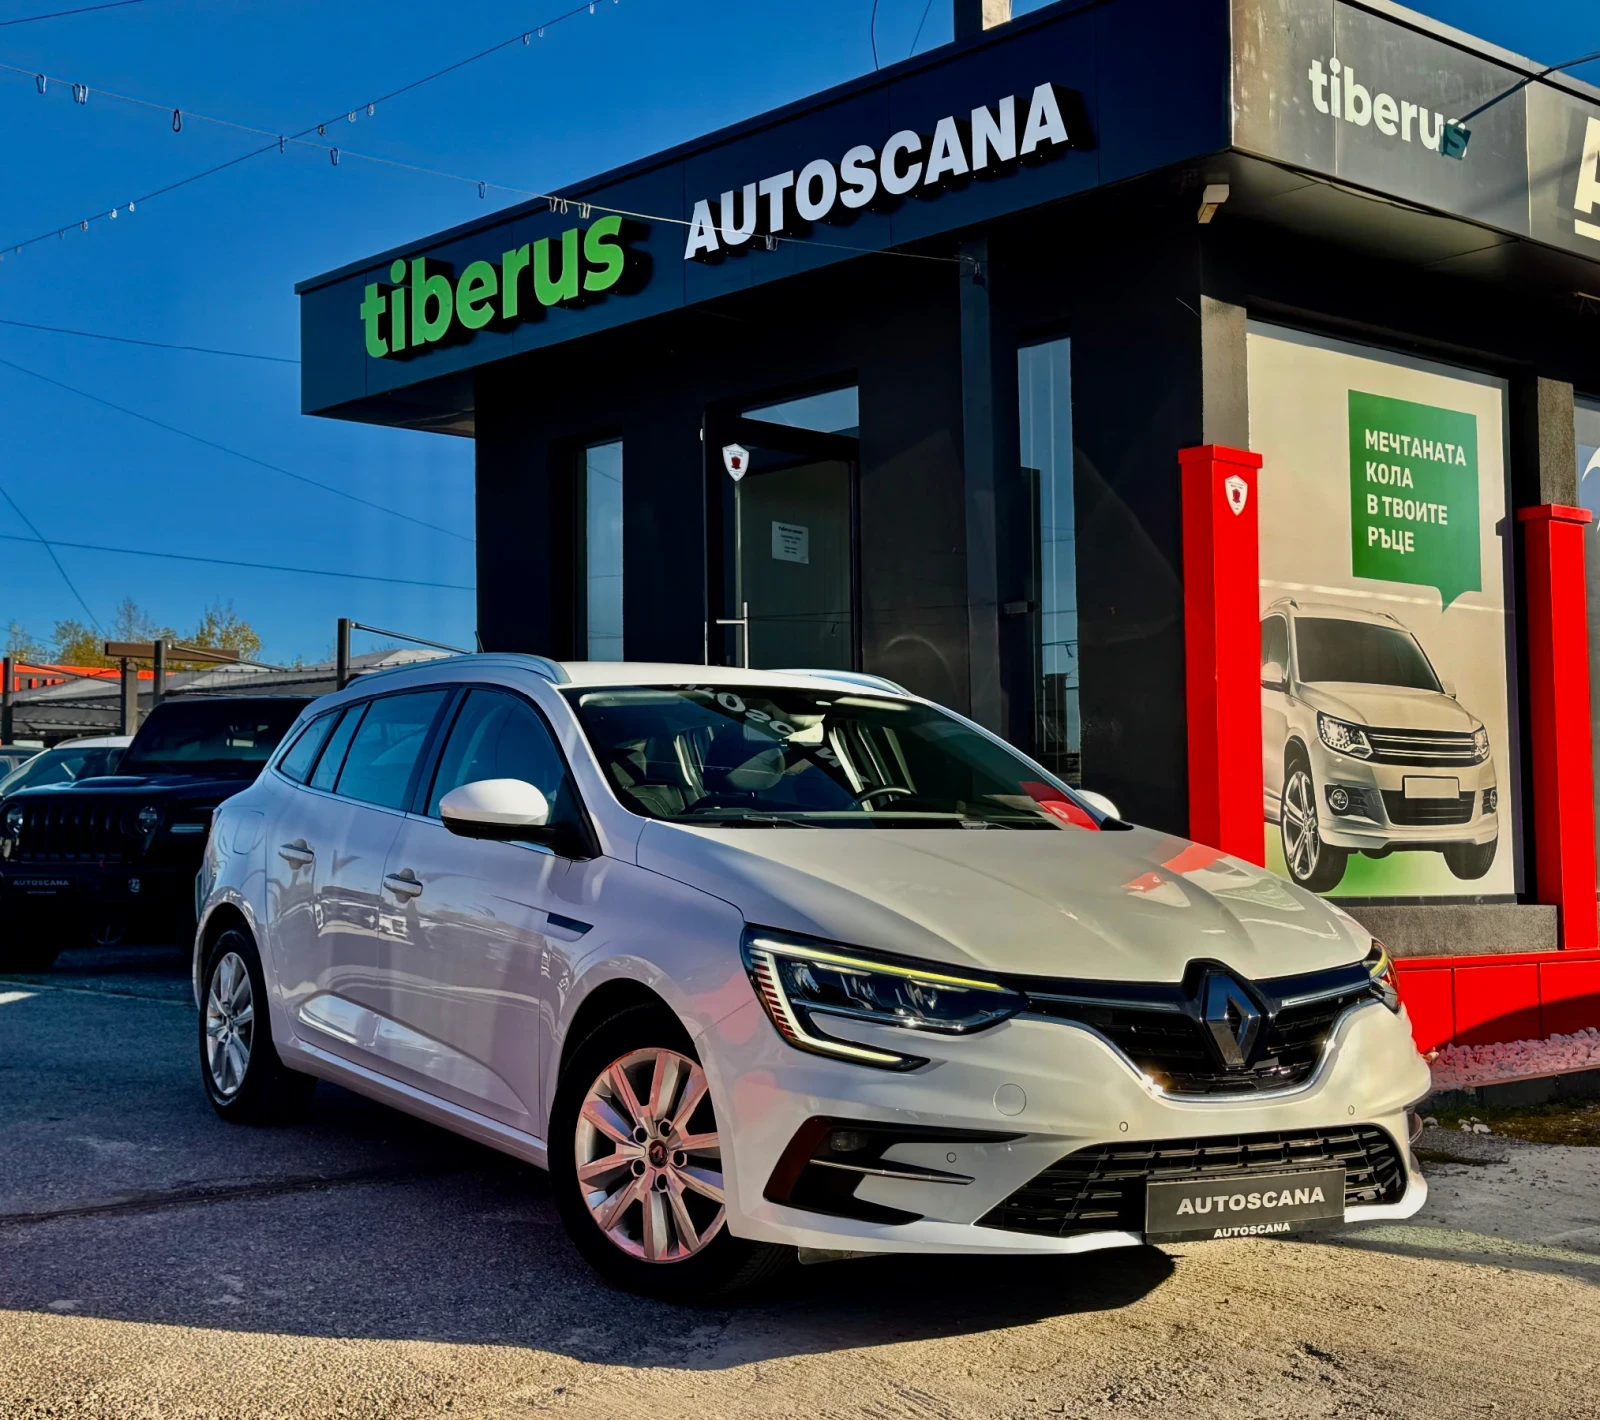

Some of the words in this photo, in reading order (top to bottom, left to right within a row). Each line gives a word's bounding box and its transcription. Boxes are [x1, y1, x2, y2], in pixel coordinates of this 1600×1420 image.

[1308, 57, 1467, 160] tiberus
[684, 82, 1068, 260] AUTOSCANA
[360, 215, 625, 358] tiberus
[1365, 428, 1467, 466] МЕЧТАНАТА
[1366, 461, 1414, 489] КОЛА
[1366, 493, 1379, 515] В
[1382, 496, 1448, 525] ТВОИТЕ
[1368, 525, 1415, 554] РЪЦЕ
[1176, 1186, 1326, 1215] AUTOSCANA
[1213, 1222, 1291, 1238] AUTOSCANA
